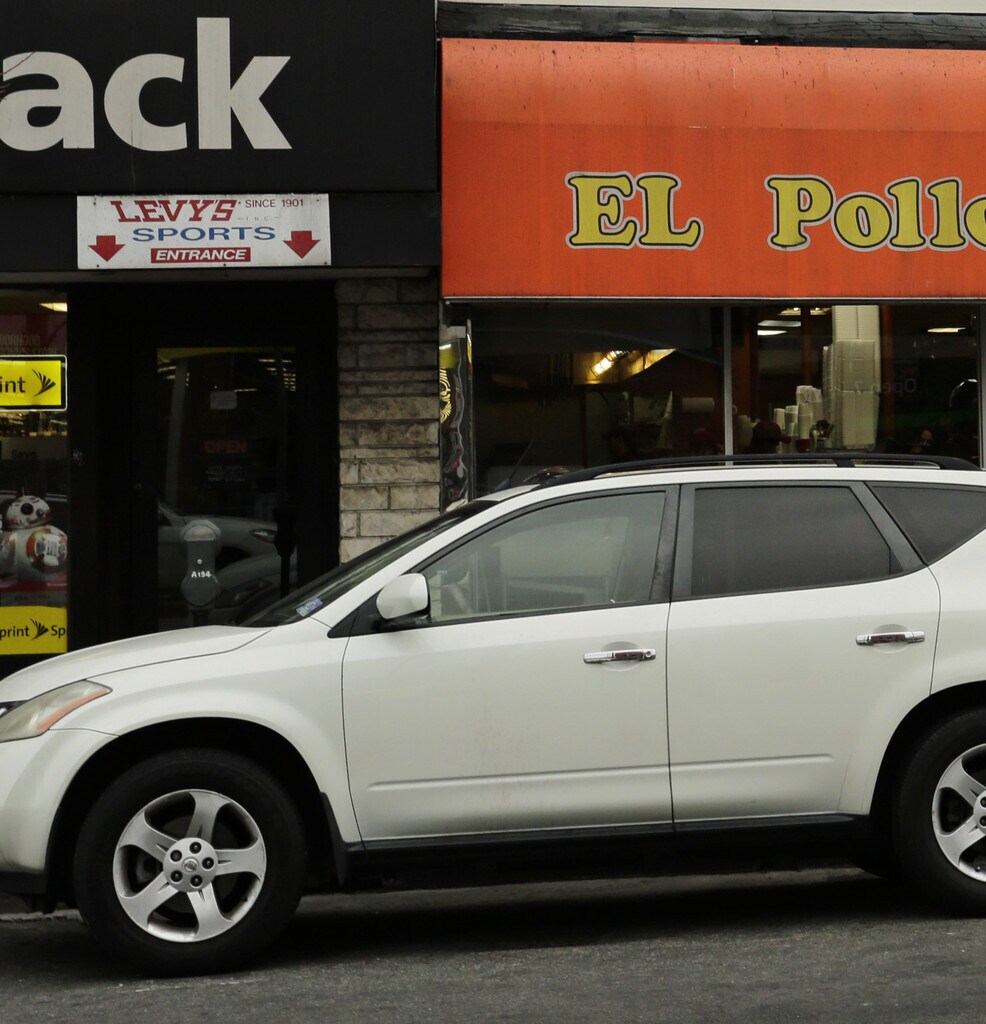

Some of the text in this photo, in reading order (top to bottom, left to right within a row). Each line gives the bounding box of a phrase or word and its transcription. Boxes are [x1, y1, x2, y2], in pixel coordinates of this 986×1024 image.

[0, 17, 292, 152] ack
[110, 198, 304, 223] LEVY'S SINCE 1901
[565, 170, 703, 250] EL
[132, 226, 276, 242] SPORTS
[155, 249, 247, 261] ENTRANCE
[203, 439, 248, 454] OPEN
